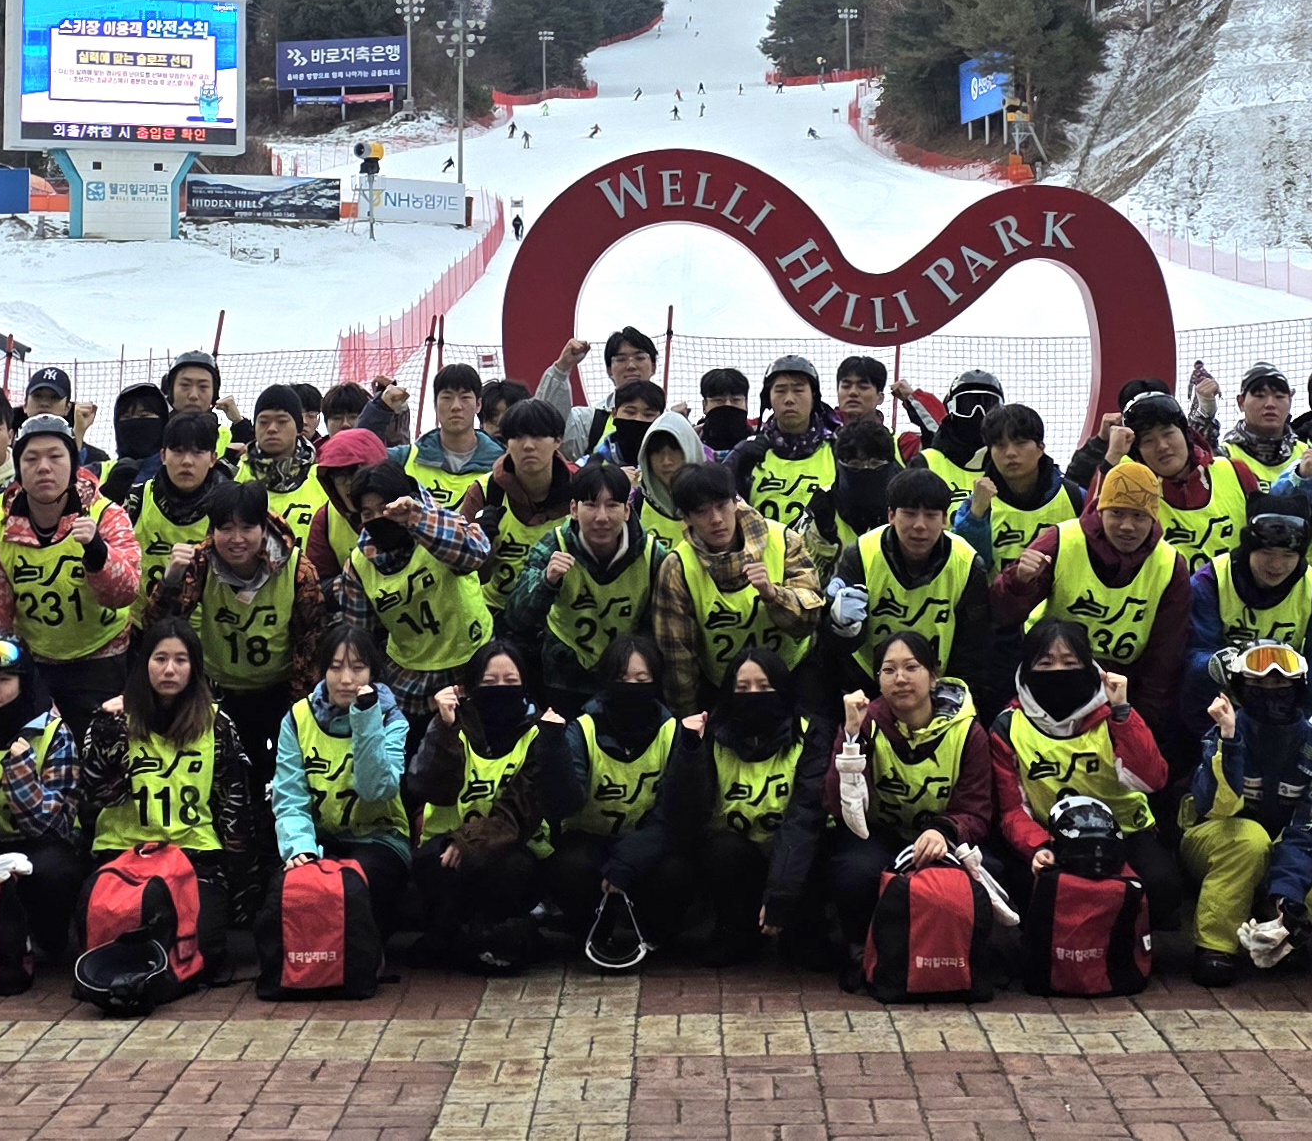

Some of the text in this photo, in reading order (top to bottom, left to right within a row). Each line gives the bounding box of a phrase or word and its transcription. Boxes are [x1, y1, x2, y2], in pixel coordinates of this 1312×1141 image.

[59, 19, 100, 35] 스키장
[146, 20, 209, 39] 안전수칙
[311, 45, 401, 65] 바로저축은행
[118, 125, 131, 139] 시
[192, 198, 264, 208] HIDDEN HILLS
[384, 191, 458, 210] NH농협카드
[595, 163, 1077, 334] WELLI HILLI PARK
[18, 588, 84, 626] 231
[397, 600, 440, 636] 14
[223, 631, 272, 667] 18
[132, 786, 201, 826] 118
